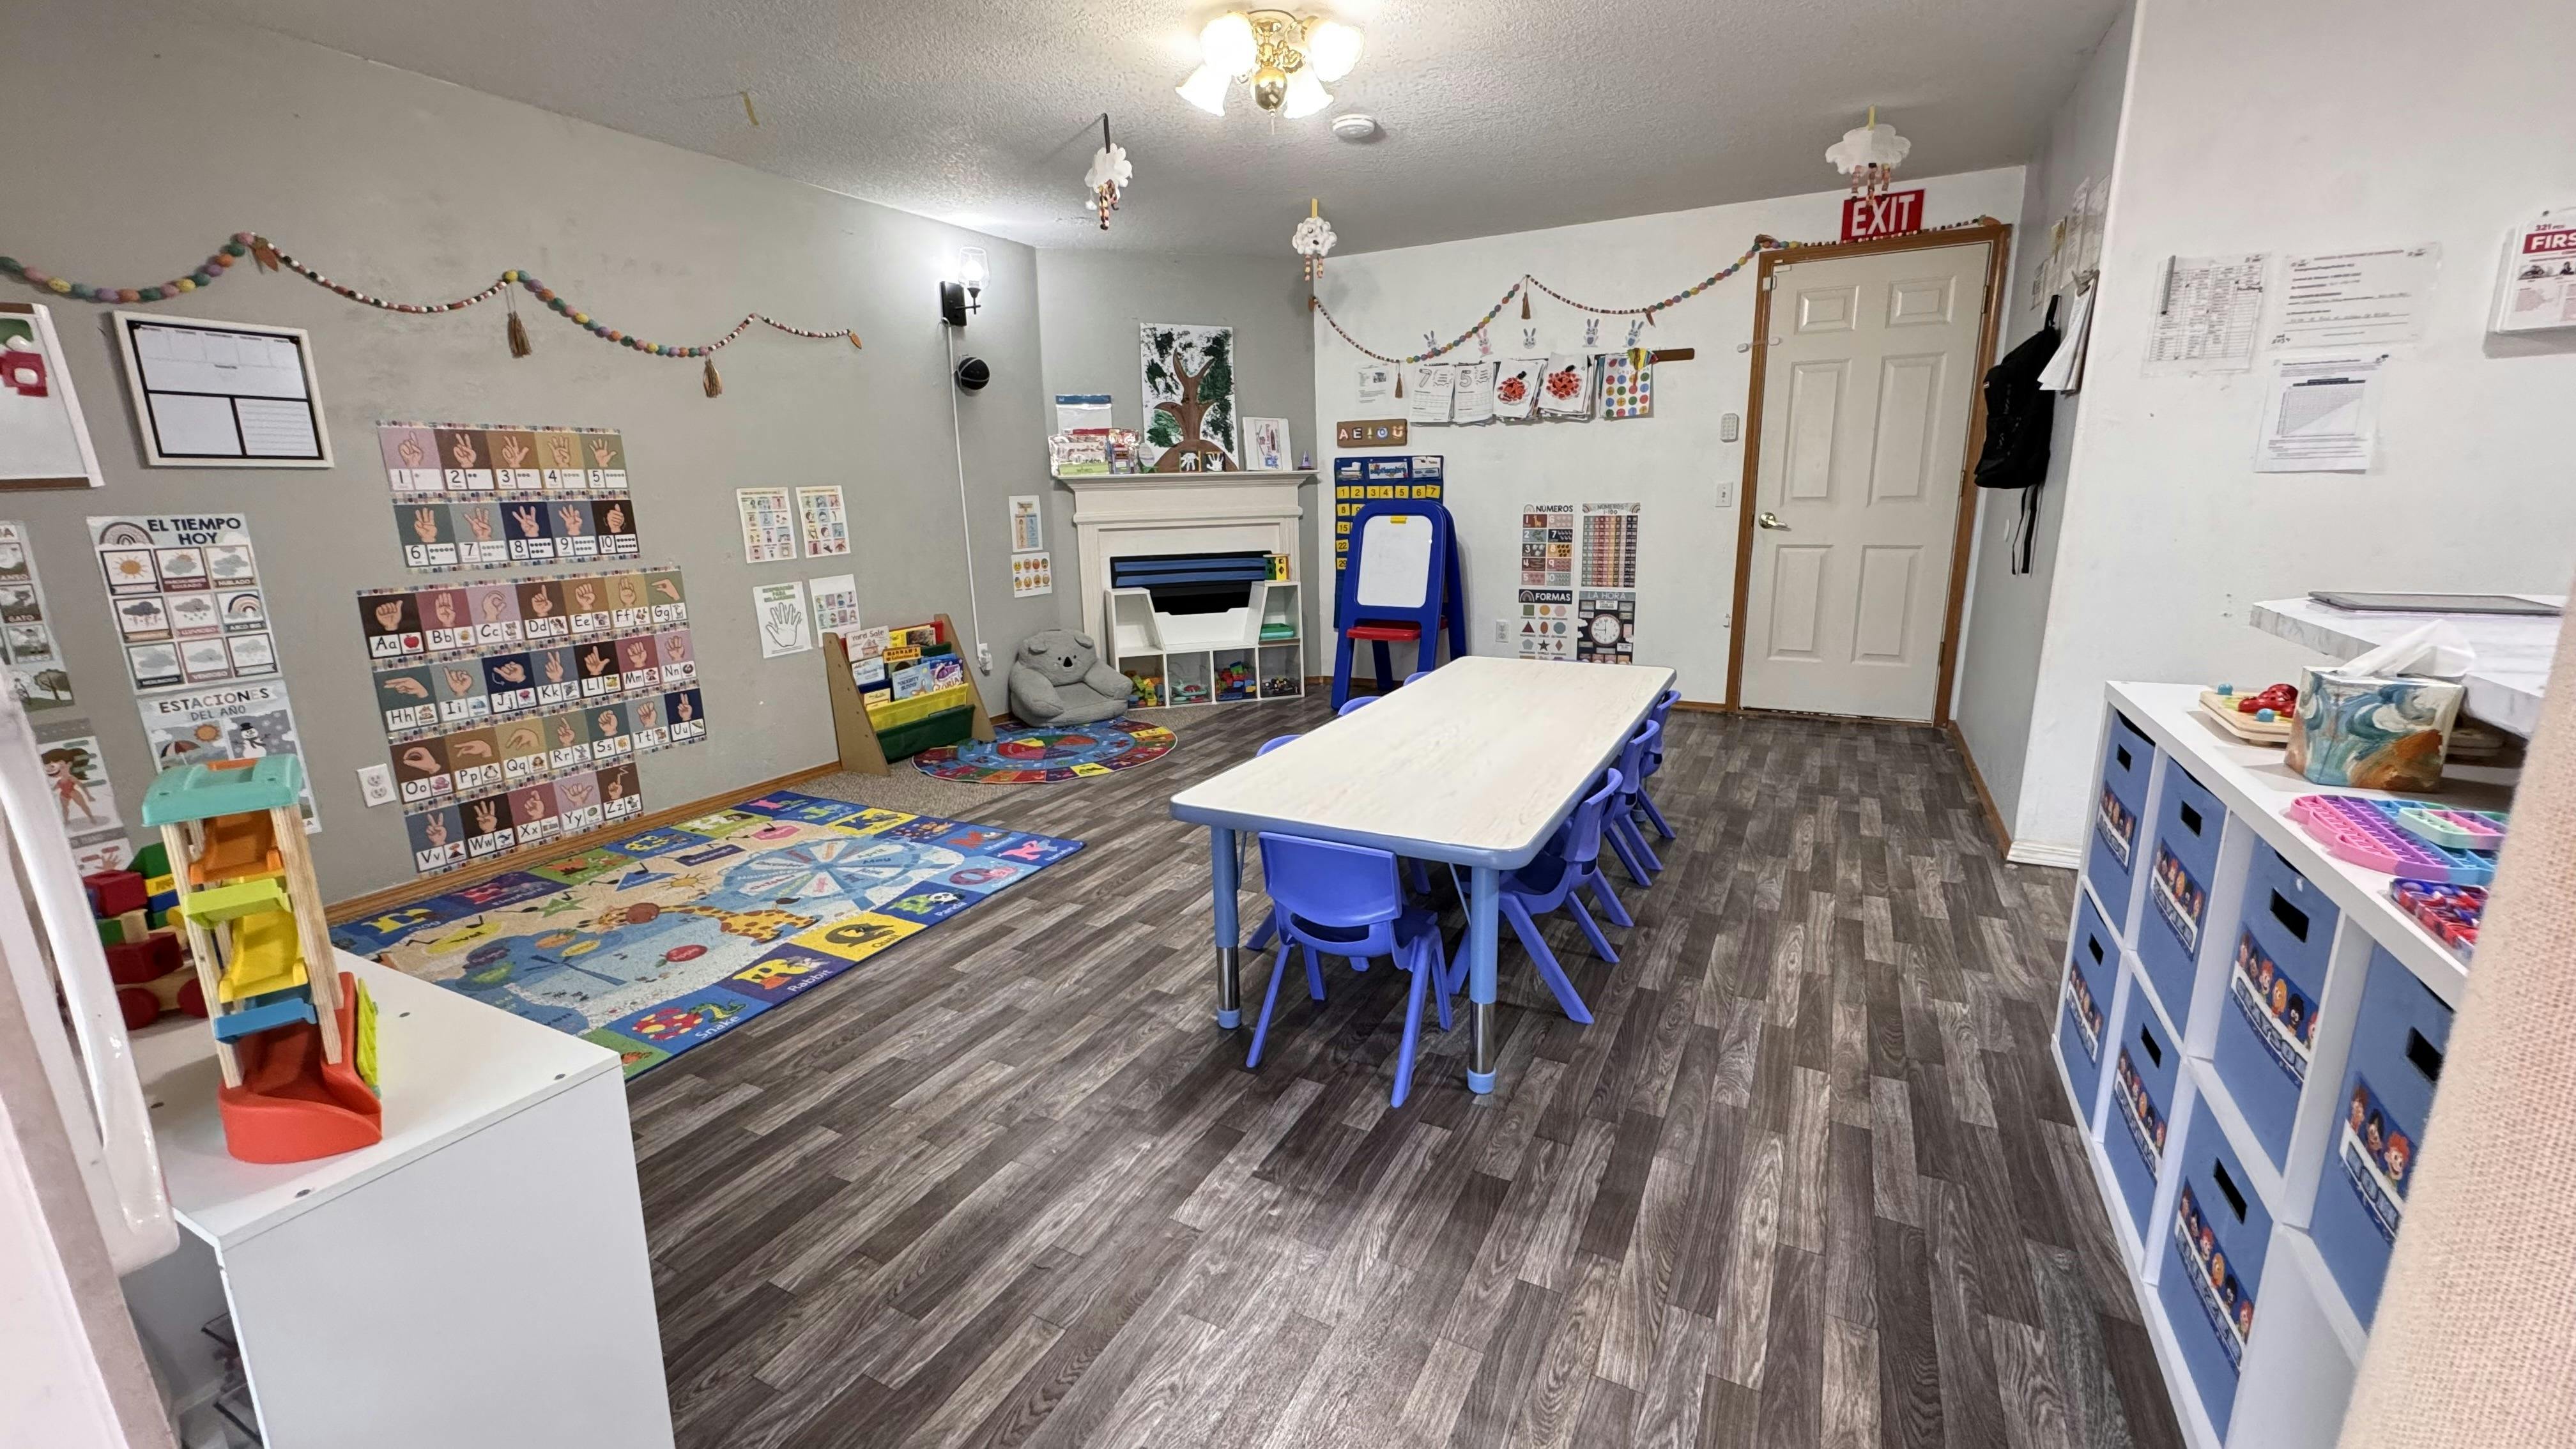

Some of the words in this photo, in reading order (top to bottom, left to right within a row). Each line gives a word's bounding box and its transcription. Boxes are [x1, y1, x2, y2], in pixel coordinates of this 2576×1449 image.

[1851, 194, 1915, 236] EXIT
[1418, 368, 1432, 388] 7
[1459, 369, 1472, 388] 5
[399, 470, 404, 484] 1
[450, 470, 461, 484] 2
[501, 470, 510, 482] 3
[548, 470, 557, 482] 4
[592, 470, 601, 482] 5
[147, 519, 169, 532] EL
[170, 517, 241, 532] TIEMPO
[1526, 515, 1529, 523] 1
[178, 532, 217, 545] HOY
[560, 537, 569, 550] 9
[601, 535, 613, 548] 10
[411, 545, 421, 560] 6
[464, 543, 473, 556] 7
[514, 540, 524, 553] 8
[0, 573, 29, 581] ANSO
[1535, 593, 1571, 601] FORMAS
[616, 610, 631, 622] Ff
[654, 606, 670, 622] Gg
[529, 620, 547, 632] Dd
[575, 615, 590, 627] Ee
[432, 630, 452, 643] Bb
[480, 624, 499, 637] Cc
[851, 632, 868, 641] Yard
[376, 636, 397, 650] Aa
[665, 665, 680, 677] Nn
[587, 678, 600, 691] Ll
[625, 673, 643, 684] Mm
[542, 687, 559, 700] Kk
[158, 687, 270, 714] ESTACIONES
[497, 693, 513, 710] Jj
[191, 710, 213, 721] DEL
[220, 704, 247, 717] AÑO
[446, 701, 462, 715] Ii
[391, 709, 413, 724] Hh
[673, 723, 688, 735] Uu
[635, 731, 652, 744] Tt
[597, 741, 613, 753] Ss
[553, 749, 570, 763] Rr
[507, 758, 526, 774] Qq
[460, 769, 478, 787] Pp
[405, 781, 427, 795] Oo
[606, 801, 624, 815] Zz
[564, 813, 582, 827] Yy
[521, 824, 539, 838] Xx
[470, 838, 493, 851] Ww
[420, 851, 441, 864] Vv
[857, 848, 887, 859] April
[934, 901, 968, 917] Panda
[871, 933, 903, 949] Quail
[786, 968, 833, 992] Rabbit
[632, 1007, 703, 1041] S
[694, 1014, 741, 1039] Snake
